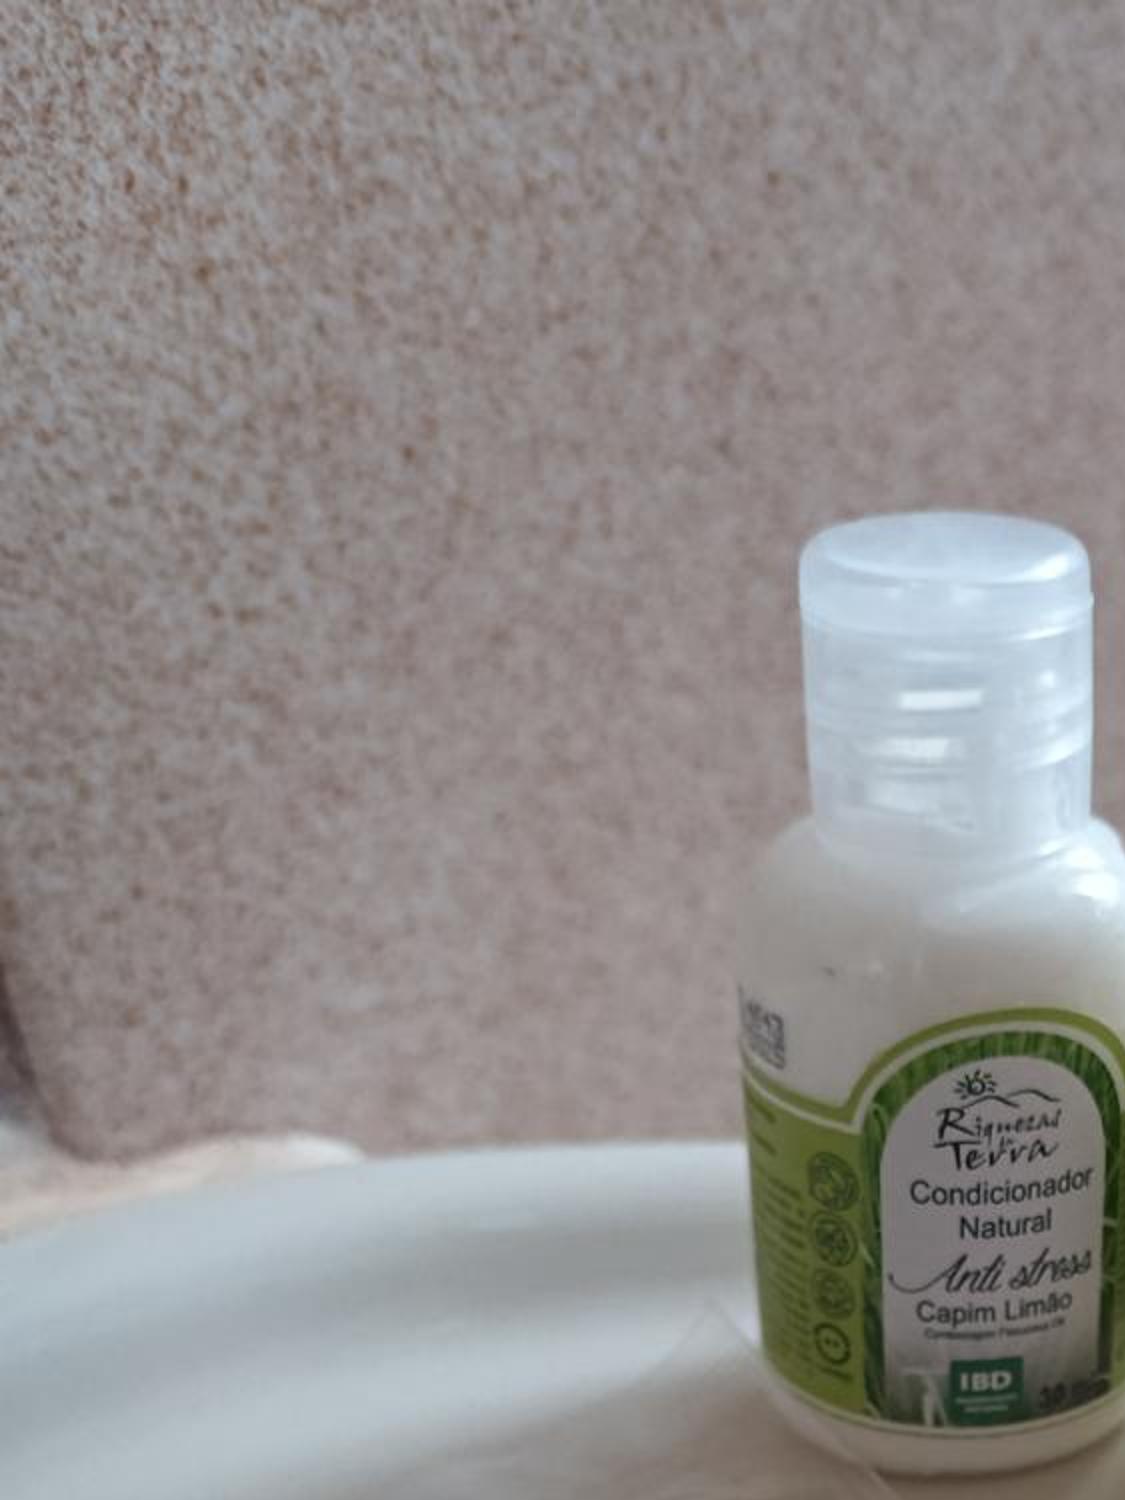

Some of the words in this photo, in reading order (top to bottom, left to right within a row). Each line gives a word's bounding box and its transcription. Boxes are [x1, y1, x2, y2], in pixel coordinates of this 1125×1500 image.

[910, 1167, 1095, 1206] Condicionador
[958, 1209, 1053, 1241] Natural
[888, 1252, 1004, 1296] Anti
[1008, 1247, 1093, 1295] stress
[916, 1299, 996, 1336] Capim
[1004, 1290, 1073, 1322] Limão
[958, 1370, 1013, 1392] IBD
